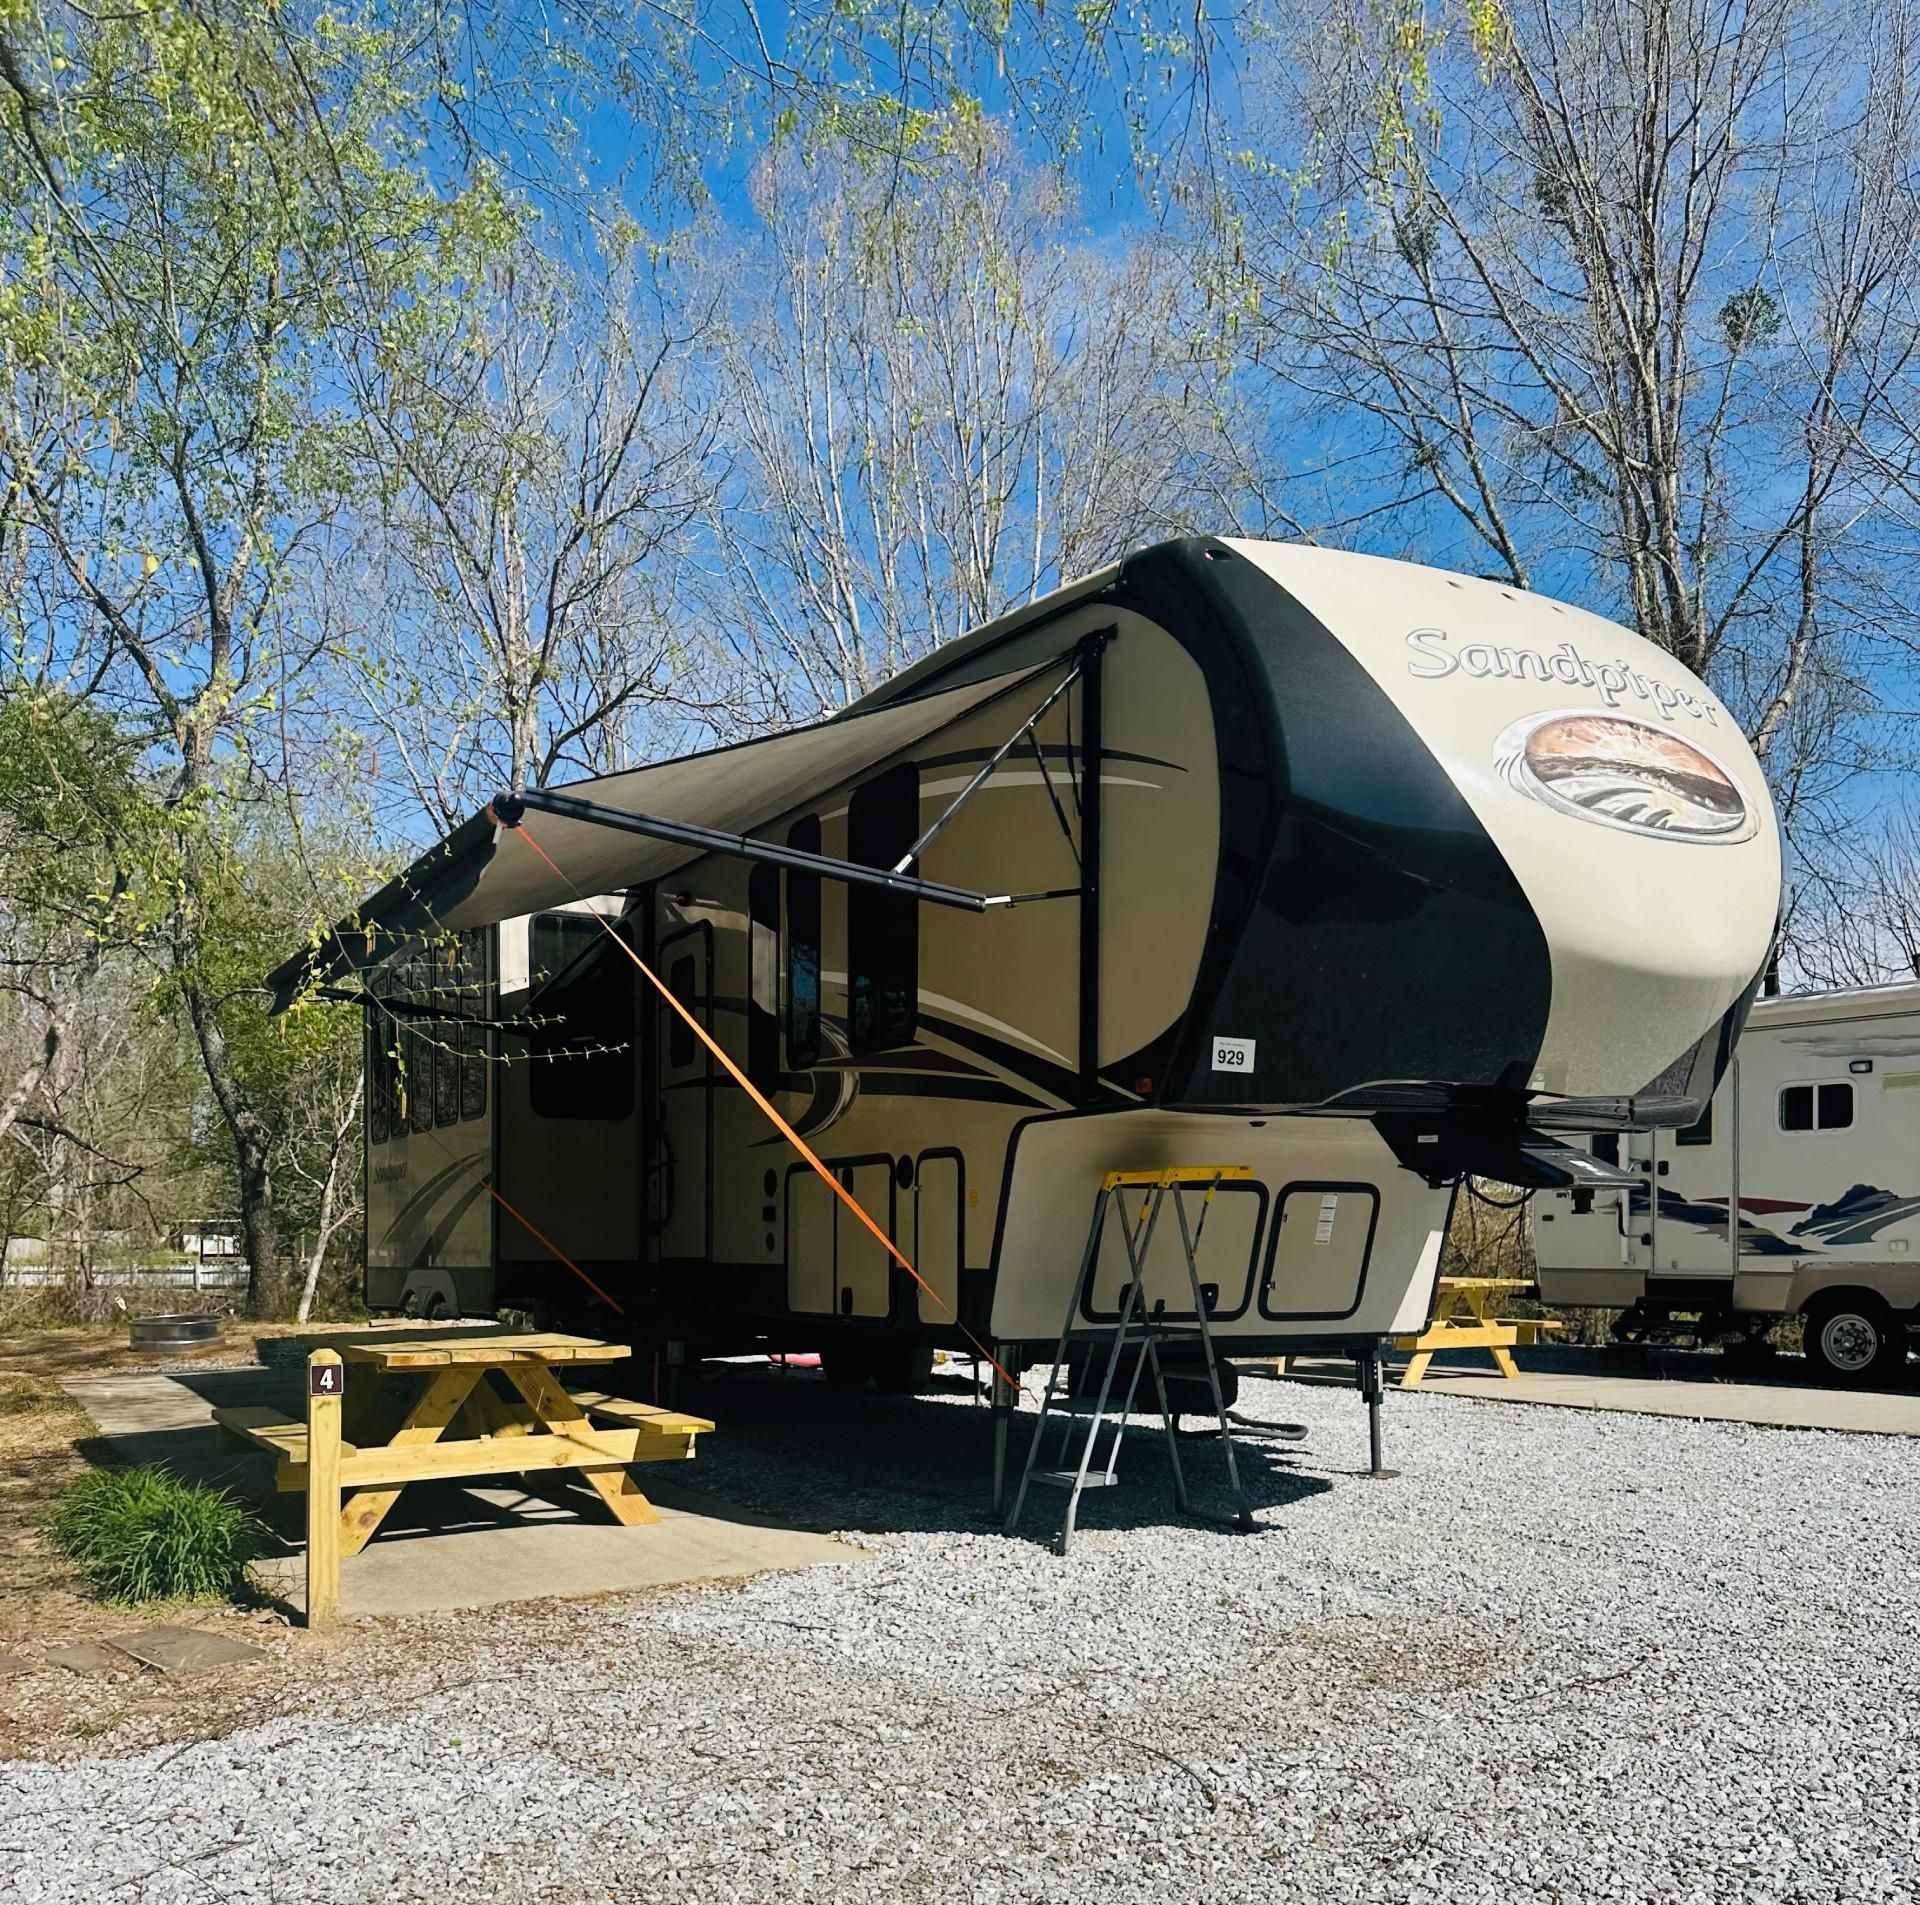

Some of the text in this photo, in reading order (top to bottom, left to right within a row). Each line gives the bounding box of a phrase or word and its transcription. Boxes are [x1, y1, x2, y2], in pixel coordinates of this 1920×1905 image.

[1406, 628, 1717, 726] Sandpiper
[1218, 1049, 1244, 1065] 929
[320, 1368, 334, 1390] 4
